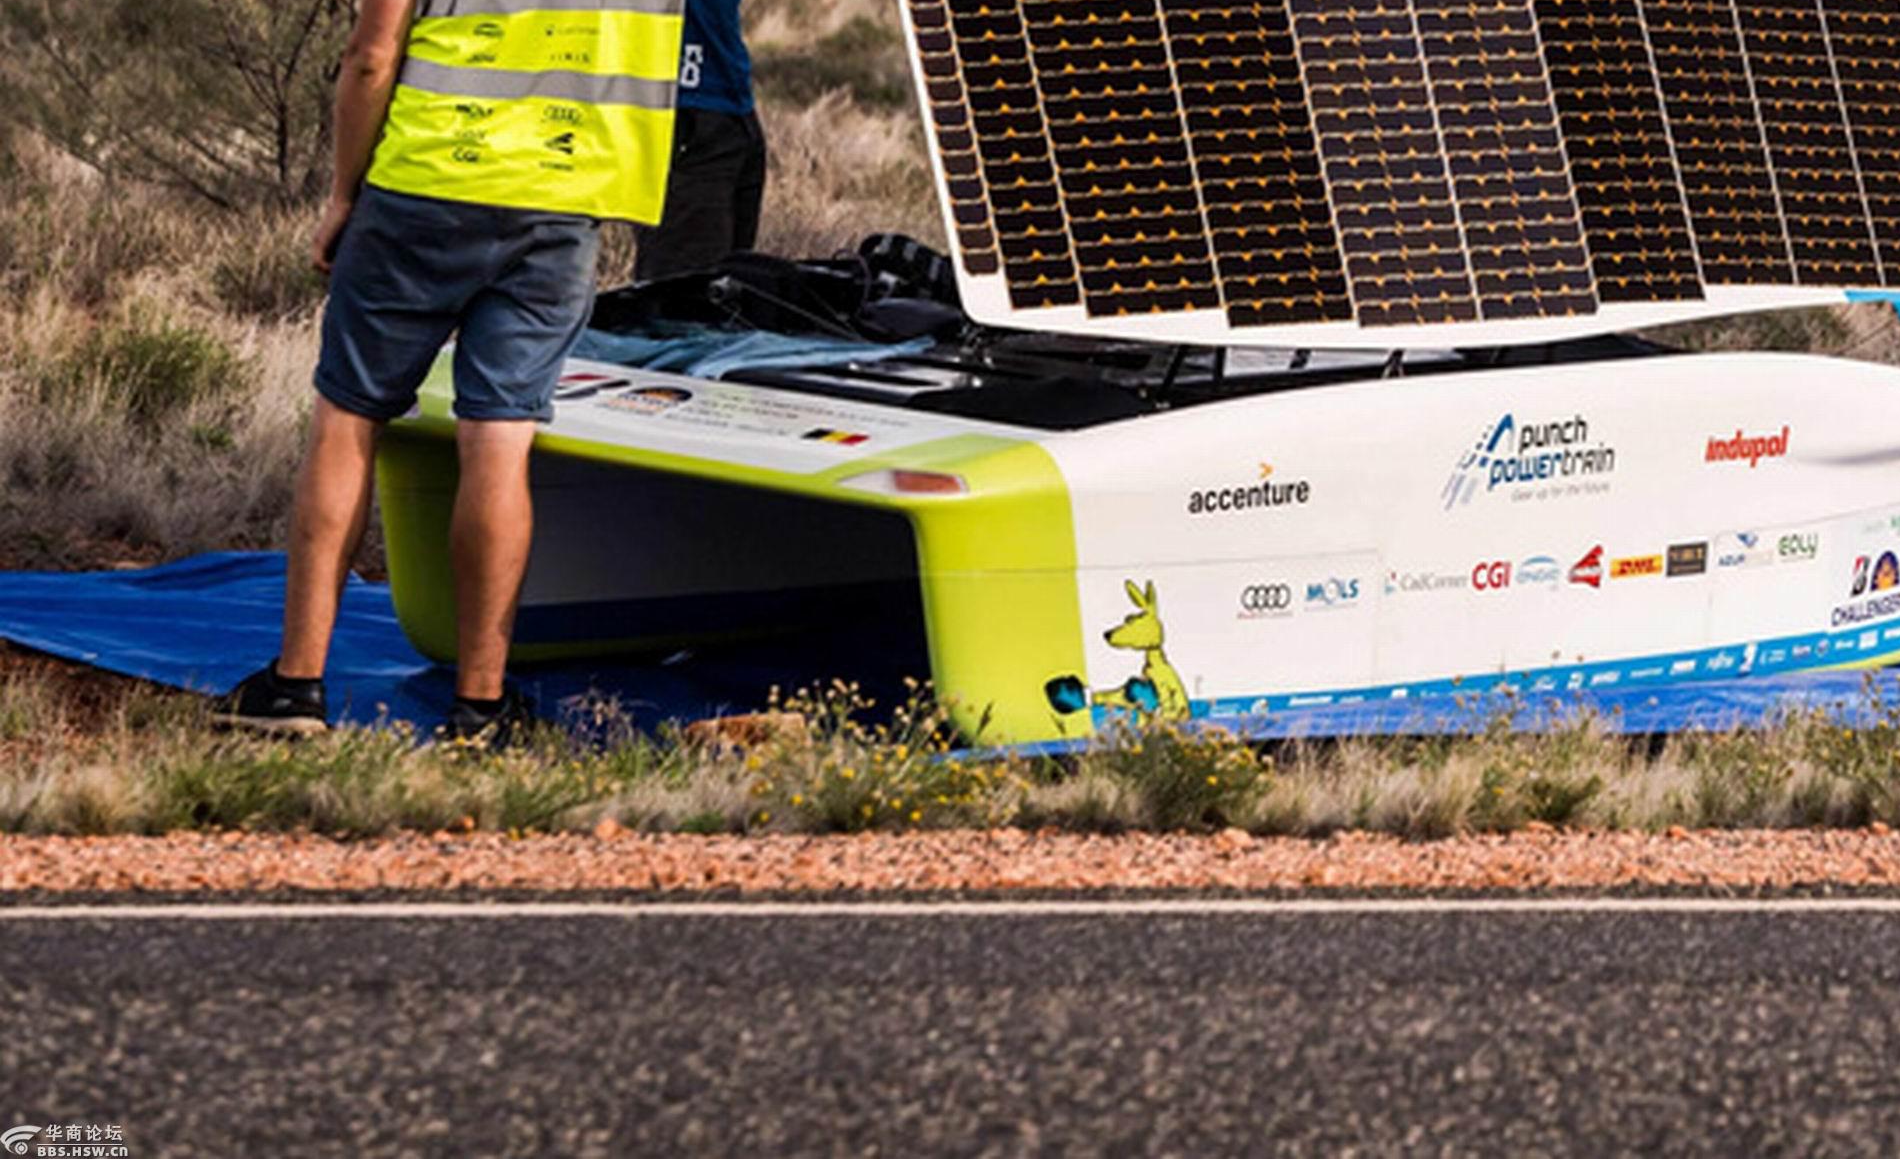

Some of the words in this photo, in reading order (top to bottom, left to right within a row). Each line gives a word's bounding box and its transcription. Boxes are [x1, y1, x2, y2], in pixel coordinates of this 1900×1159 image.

[1518, 415, 1588, 455] punch
[1487, 442, 1615, 491] powertrain
[1188, 481, 1310, 514] accenture
[1472, 561, 1512, 591] CGI
